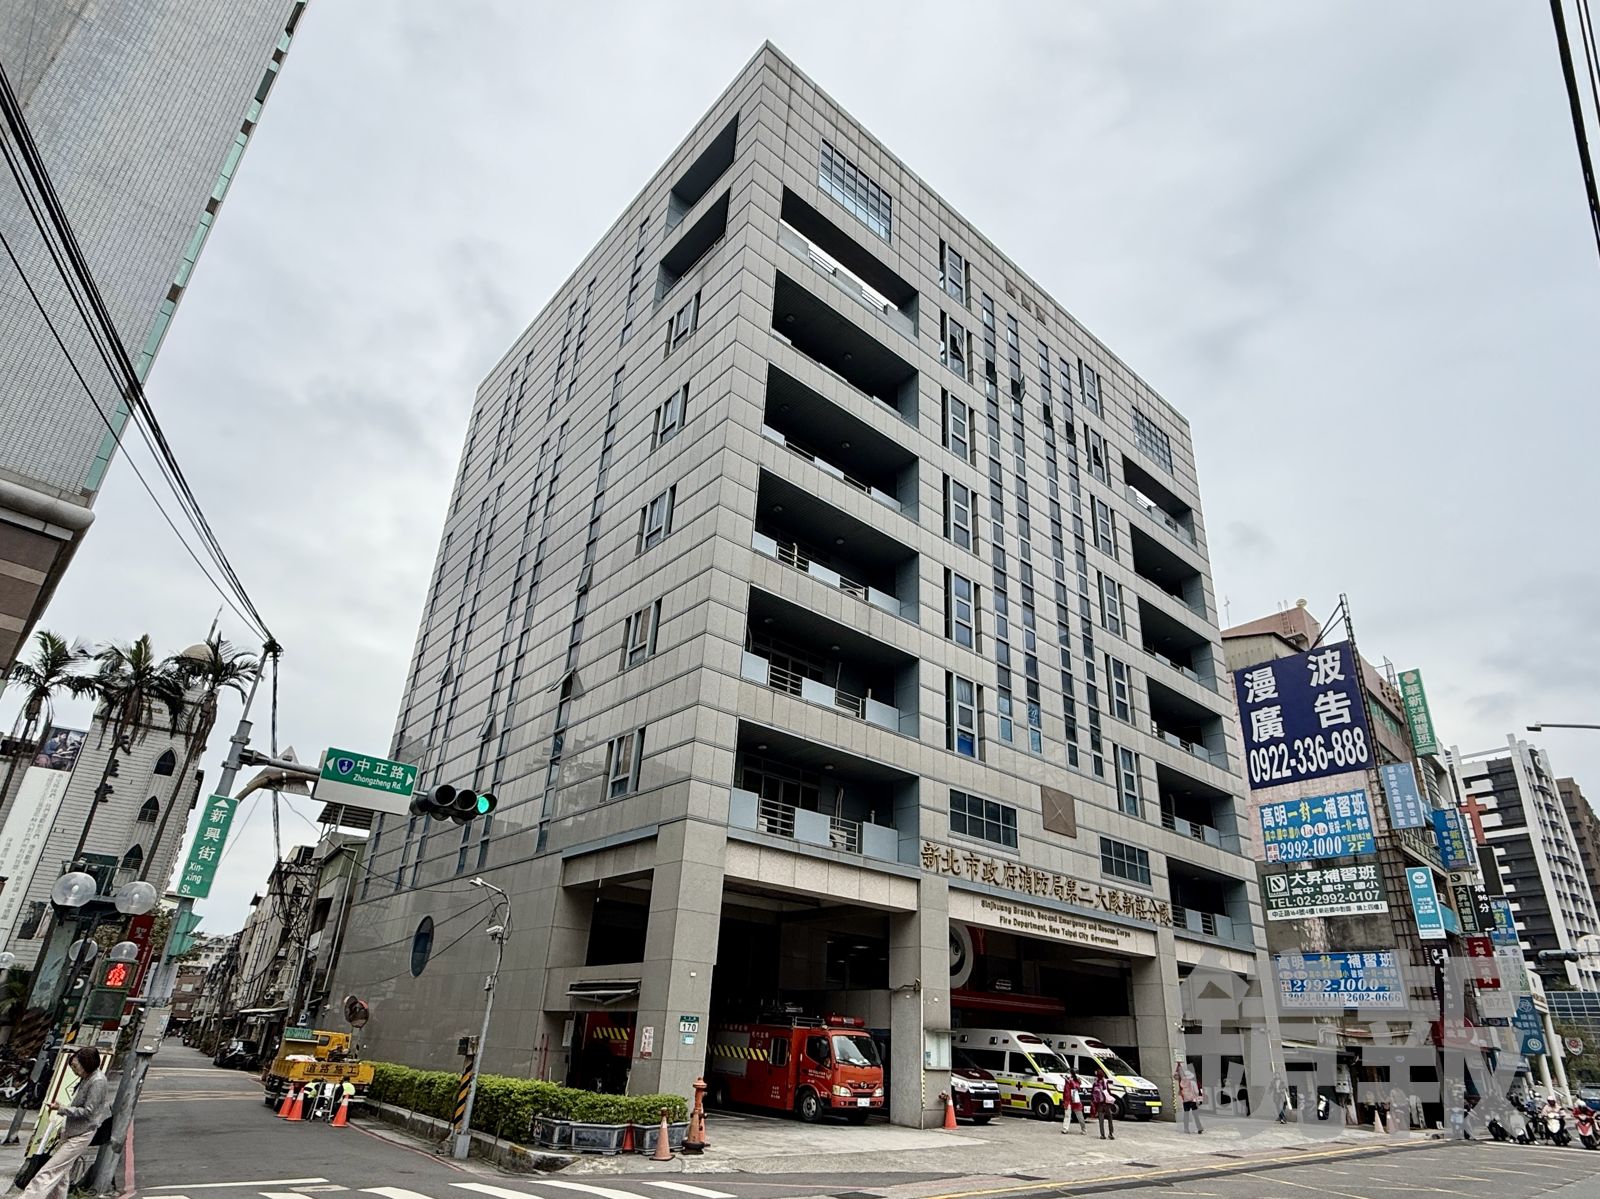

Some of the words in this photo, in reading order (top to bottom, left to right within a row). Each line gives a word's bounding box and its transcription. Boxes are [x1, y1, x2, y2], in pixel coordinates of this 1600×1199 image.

[1250, 727, 1368, 783] 0922-336-888
[356, 758, 404, 779] 中正路
[353, 773, 391, 789] Zhongzheng
[1261, 792, 1367, 828] 高明一對一補習班
[198, 808, 228, 861] 新興街
[1280, 836, 1342, 860] 2992-1000
[1348, 841, 1366, 852] 2F
[188, 862, 203, 872] Xin-
[1289, 865, 1377, 887] 大昇補習班
[1269, 890, 1380, 908] TEL:02-2992-0107
[1013, 904, 1037, 919] Branch,
[1037, 911, 1058, 923] Second
[1058, 916, 1087, 931] Emergency
[1088, 922, 1097, 932] and
[1116, 927, 1131, 938] Corps
[1000, 916, 1012, 926] Fire
[1013, 918, 1048, 933] Department,
[1049, 925, 1060, 935] New
[1061, 928, 1077, 938] Taipei
[1078, 932, 1089, 942] City
[1091, 933, 1119, 946] Government
[1277, 952, 1394, 970] 高明一對一補習班
[1293, 979, 1379, 992] 2992-1000
[1347, 992, 1401, 1002] 2602-0666
[682, 1023, 697, 1032] 170
